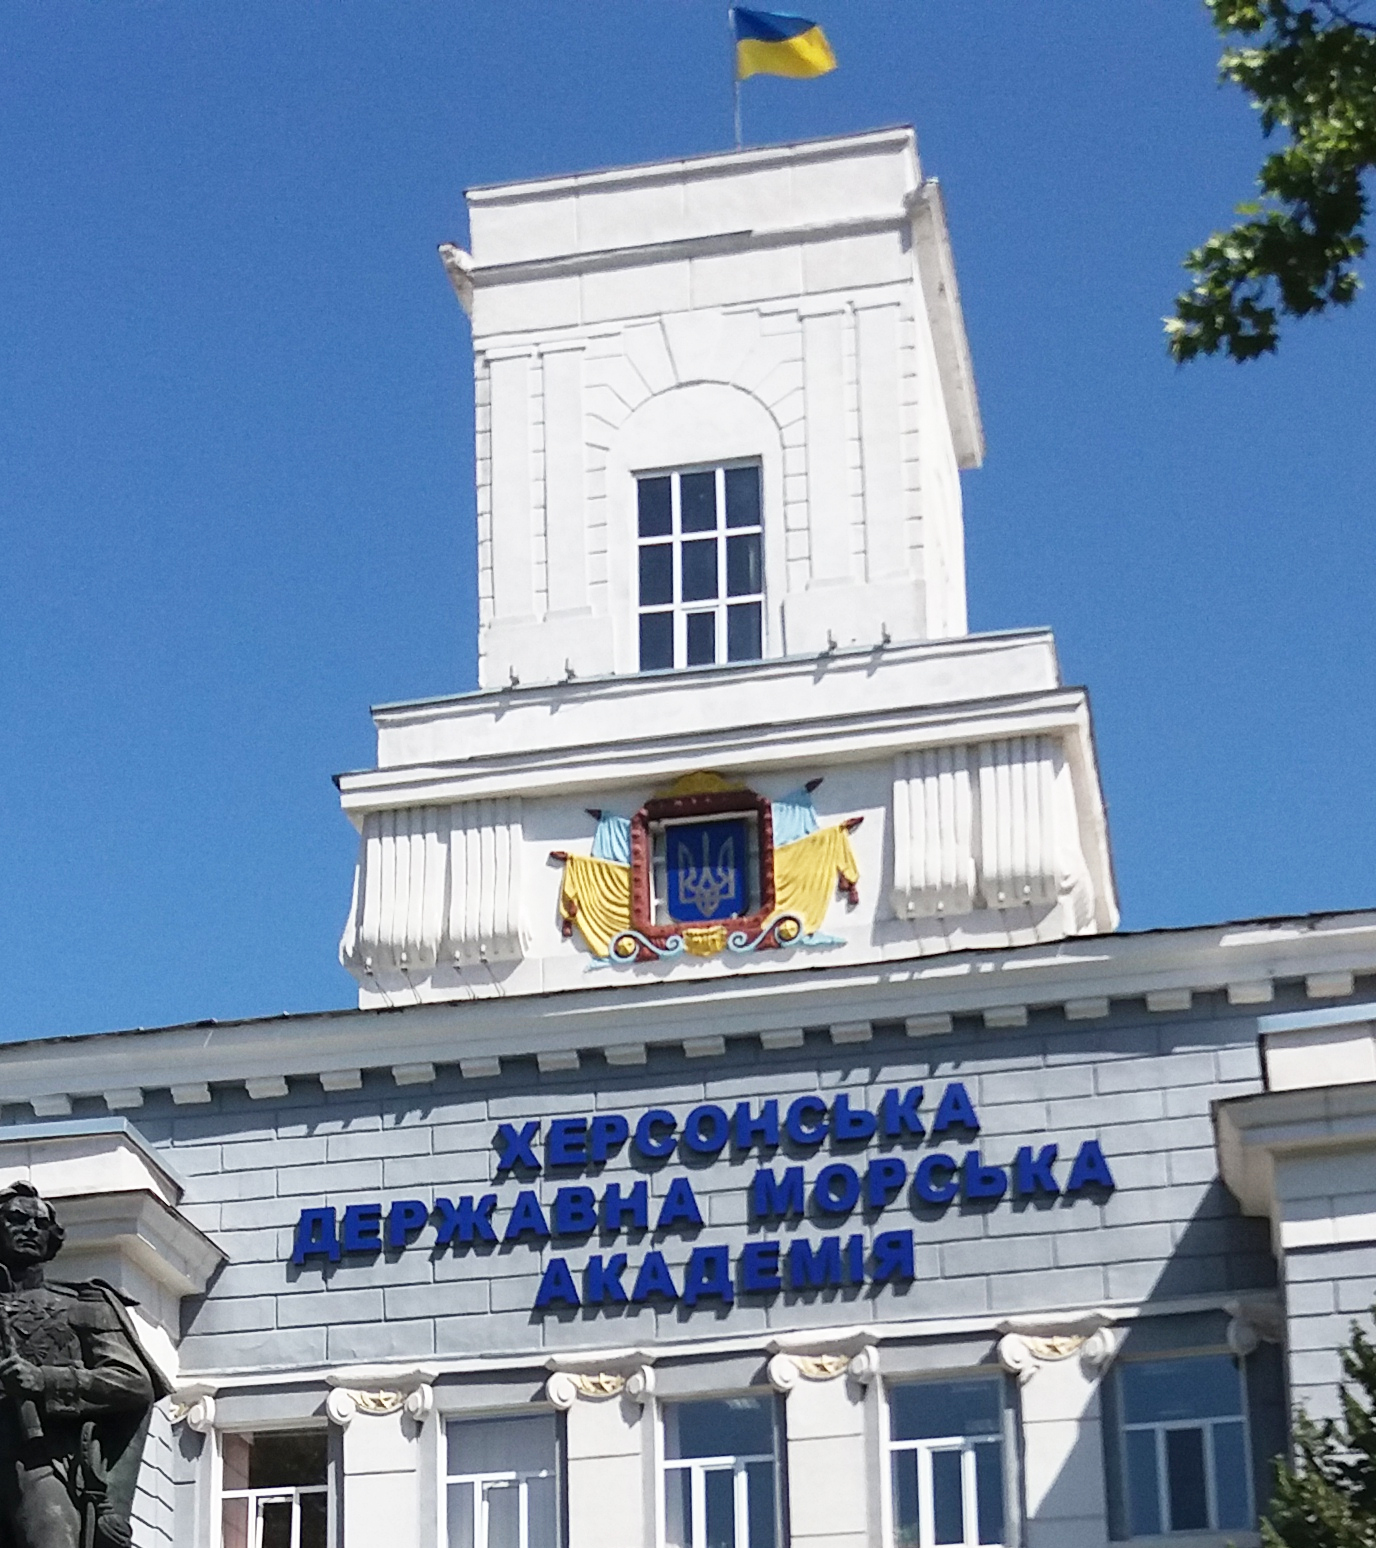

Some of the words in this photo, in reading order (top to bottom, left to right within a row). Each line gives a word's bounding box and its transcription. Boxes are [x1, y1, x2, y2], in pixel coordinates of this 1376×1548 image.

[498, 1082, 980, 1169] ХЕРСОНСЬКА
[292, 1177, 702, 1264] ДЕРЖАВНА
[753, 1140, 1115, 1215] МОРСЬКА
[535, 1229, 916, 1307] АКАДЕМІЯ
